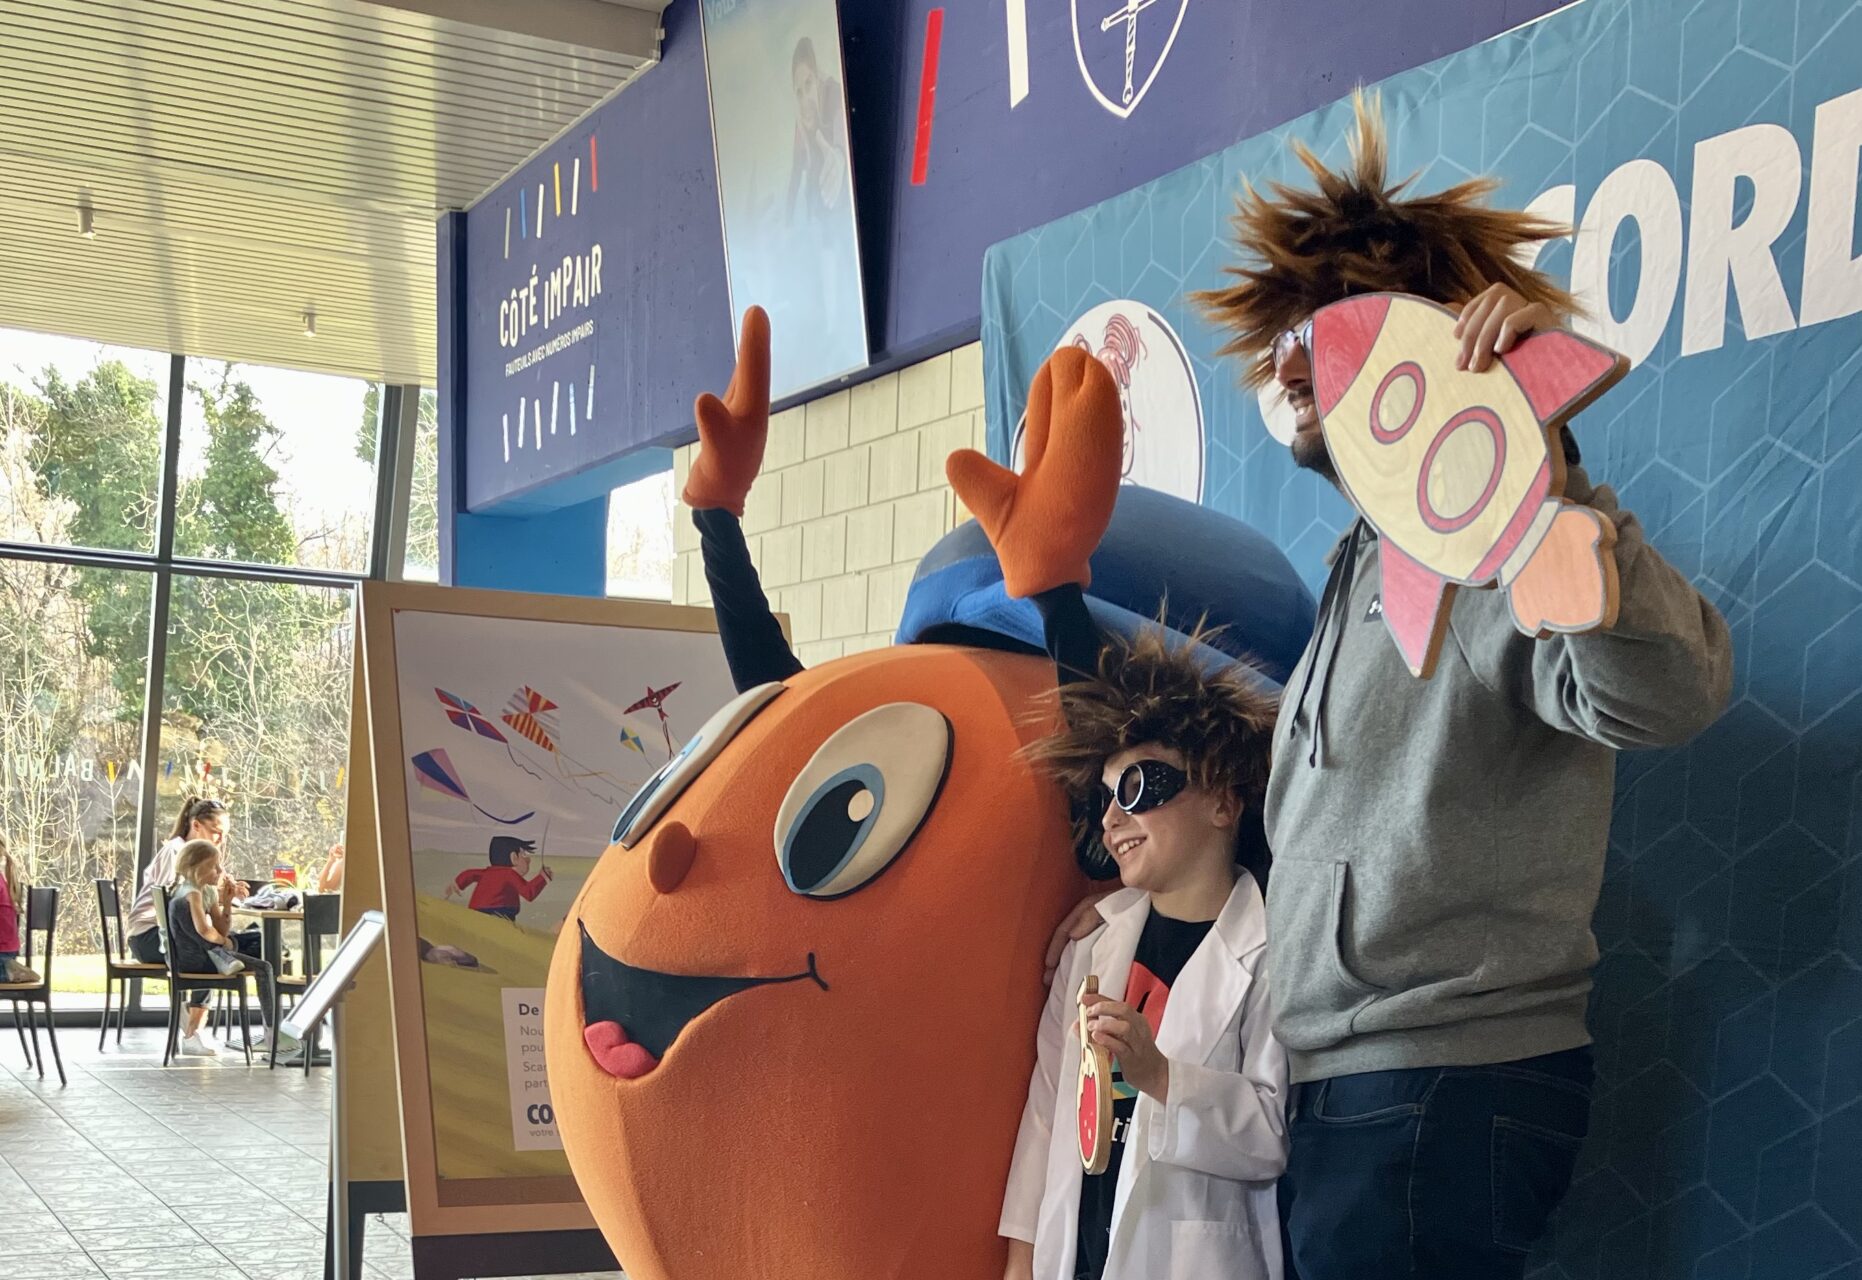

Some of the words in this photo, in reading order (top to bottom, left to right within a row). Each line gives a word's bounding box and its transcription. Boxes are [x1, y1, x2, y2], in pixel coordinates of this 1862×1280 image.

[499, 264, 538, 347] CÔTÉ
[544, 244, 602, 329] IMPAIR
[532, 345, 545, 362] AVEC
[545, 332, 571, 357] NUMÉROS
[571, 319, 595, 344] IMPAIRS
[518, 1003, 540, 1016] De
[527, 1103, 557, 1126] CO
